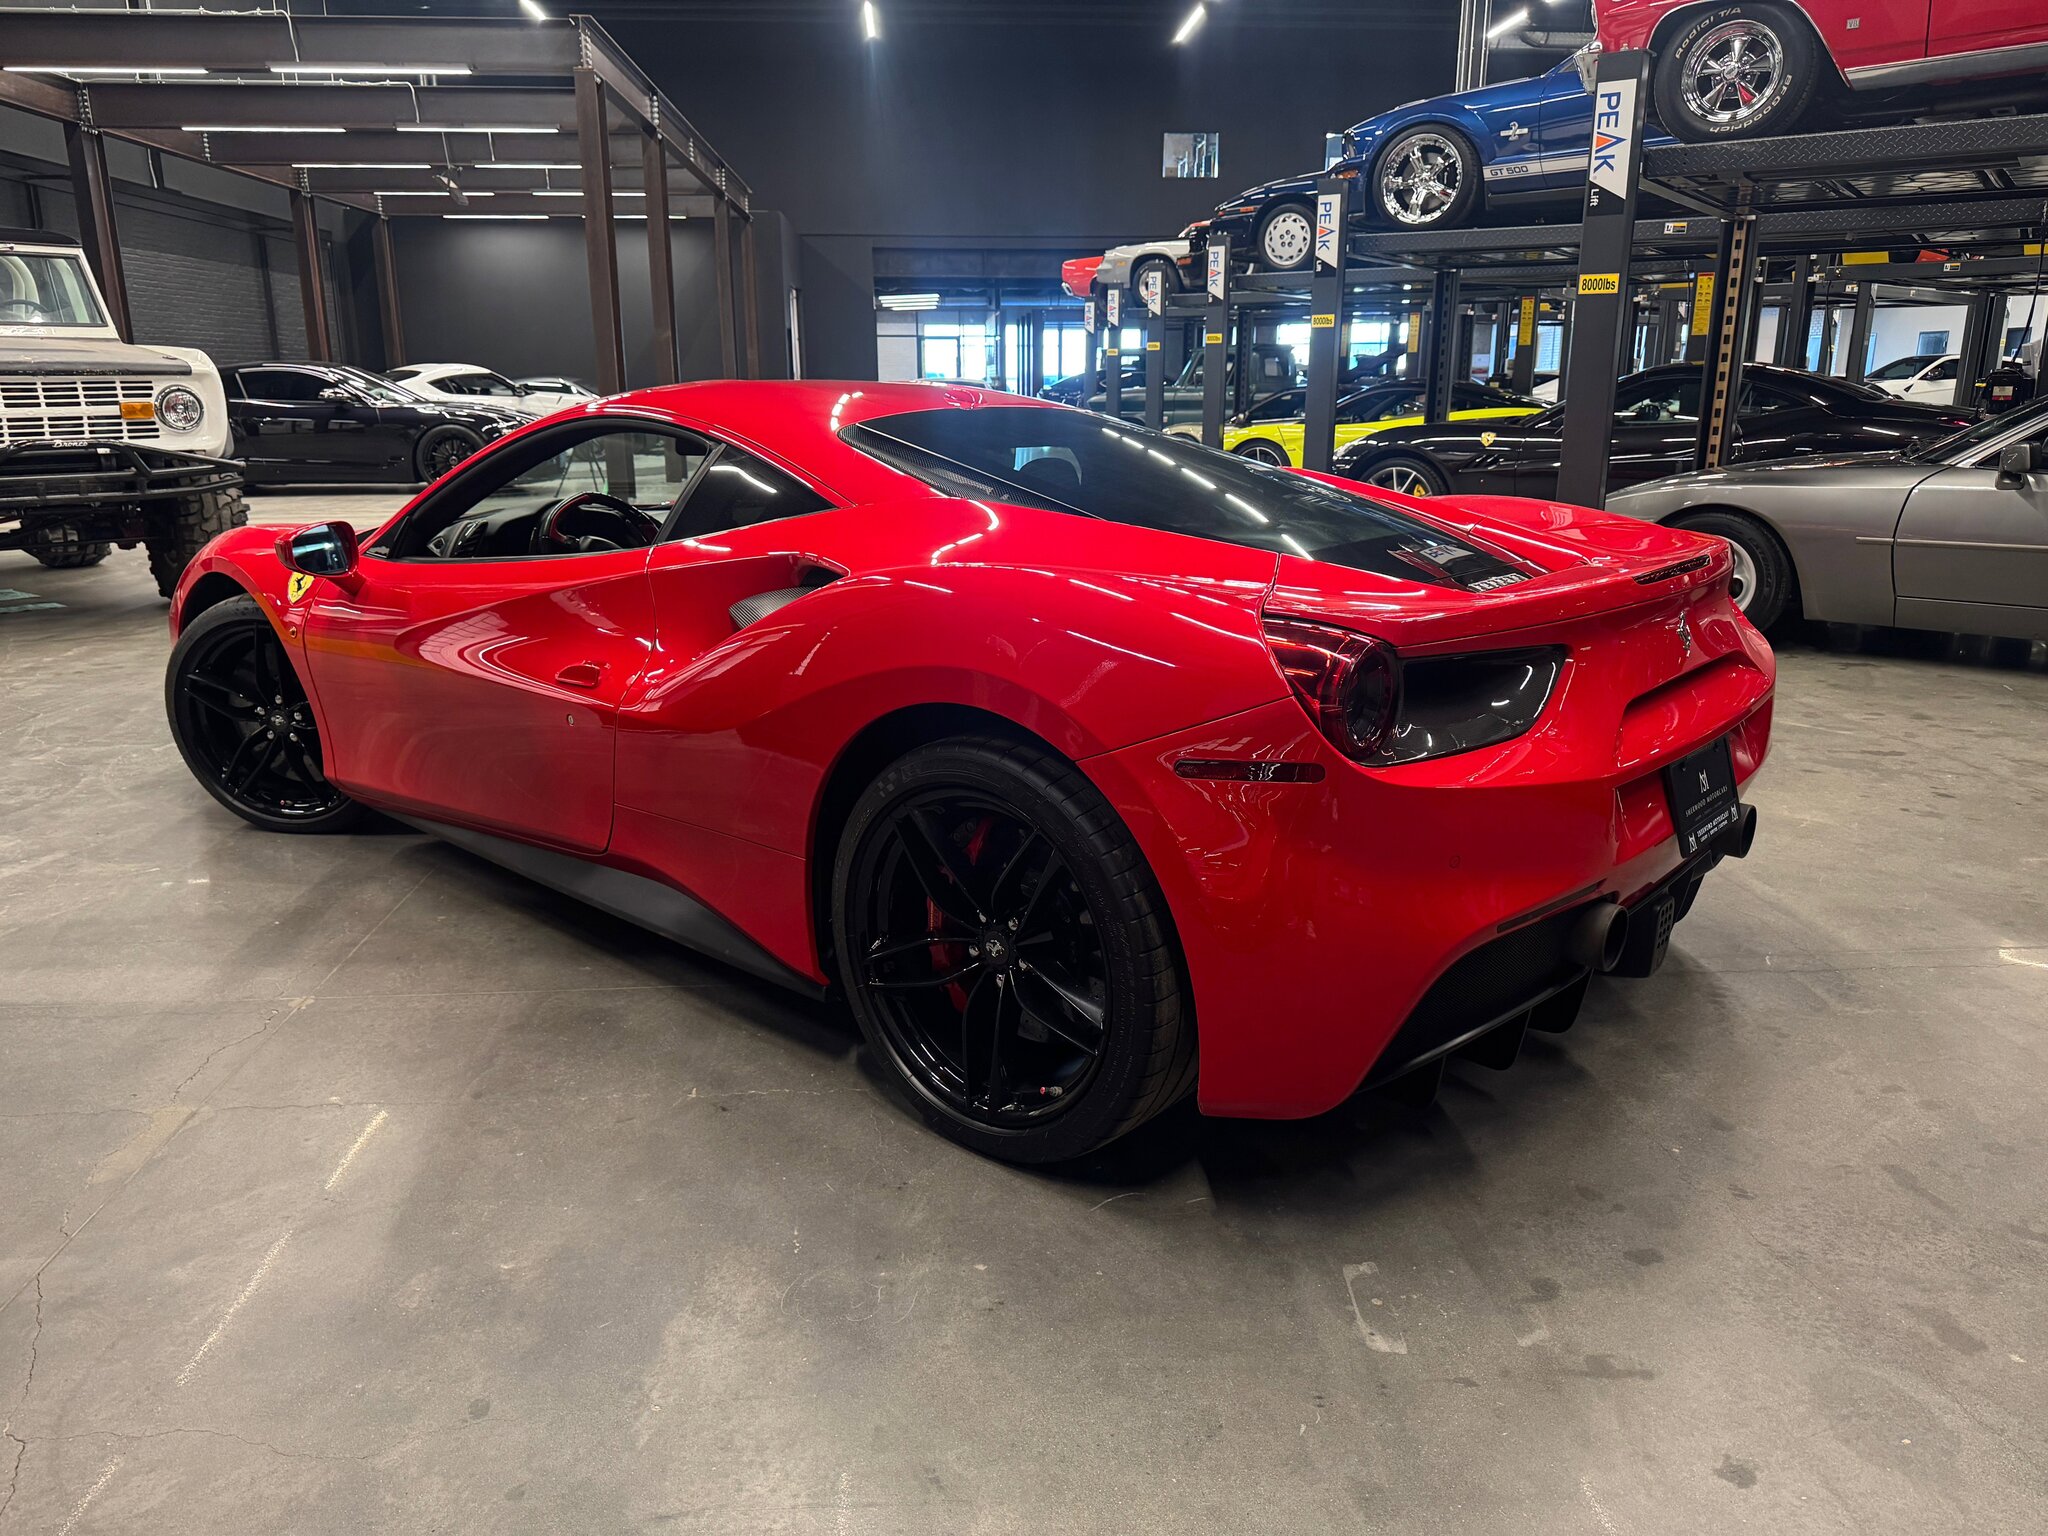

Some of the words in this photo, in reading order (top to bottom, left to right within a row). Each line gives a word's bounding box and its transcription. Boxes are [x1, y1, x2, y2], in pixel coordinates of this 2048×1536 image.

[1675, 16, 1714, 60] Radial
[1718, 7, 1742, 18] T/A
[1593, 91, 1628, 174] PEAK
[1490, 168, 1505, 177] GT
[1506, 165, 1529, 175] 500
[1590, 188, 1600, 207] Lift
[1317, 201, 1336, 252] PEAK
[1209, 251, 1221, 287] PEAK
[1582, 278, 1616, 291] 8000lbs
[1149, 276, 1159, 305] PEAK
